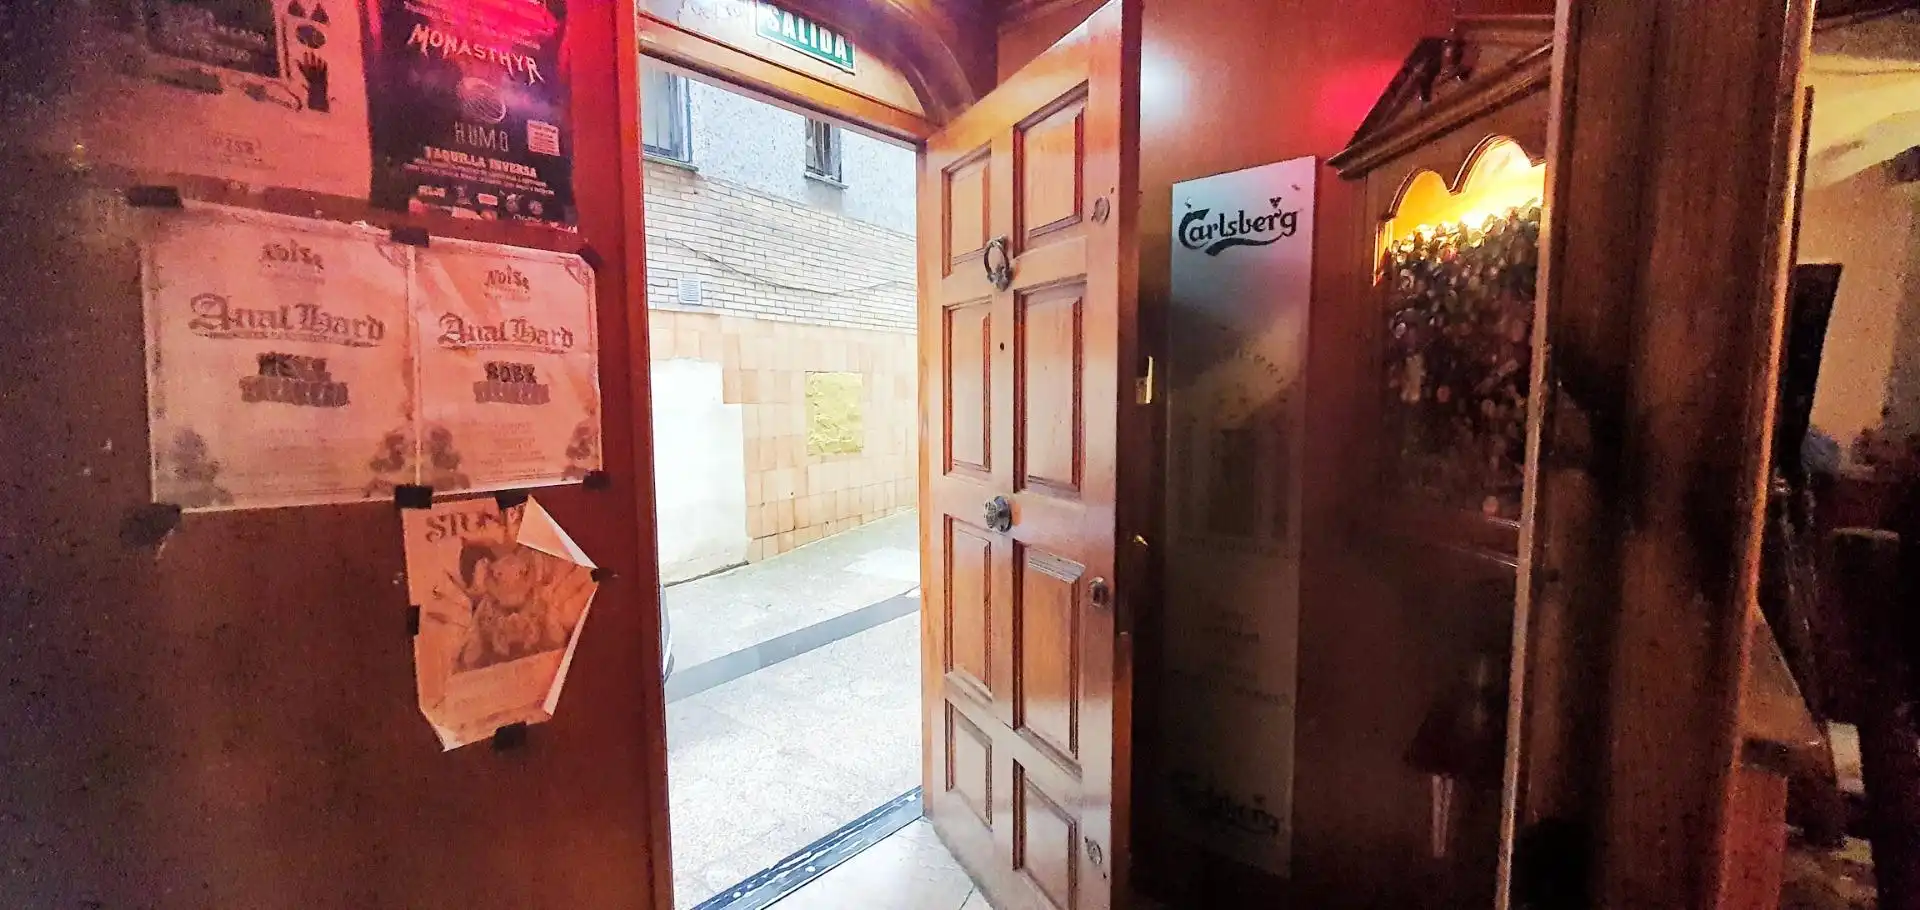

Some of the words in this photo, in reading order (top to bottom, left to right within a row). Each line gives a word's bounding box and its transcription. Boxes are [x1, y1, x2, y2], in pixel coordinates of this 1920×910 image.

[766, 4, 848, 59] SALIDA
[454, 121, 508, 152] HUMO
[424, 146, 486, 168] TAQUILLA
[489, 158, 537, 178] INVERSA
[1178, 201, 1303, 257] Carlsberg
